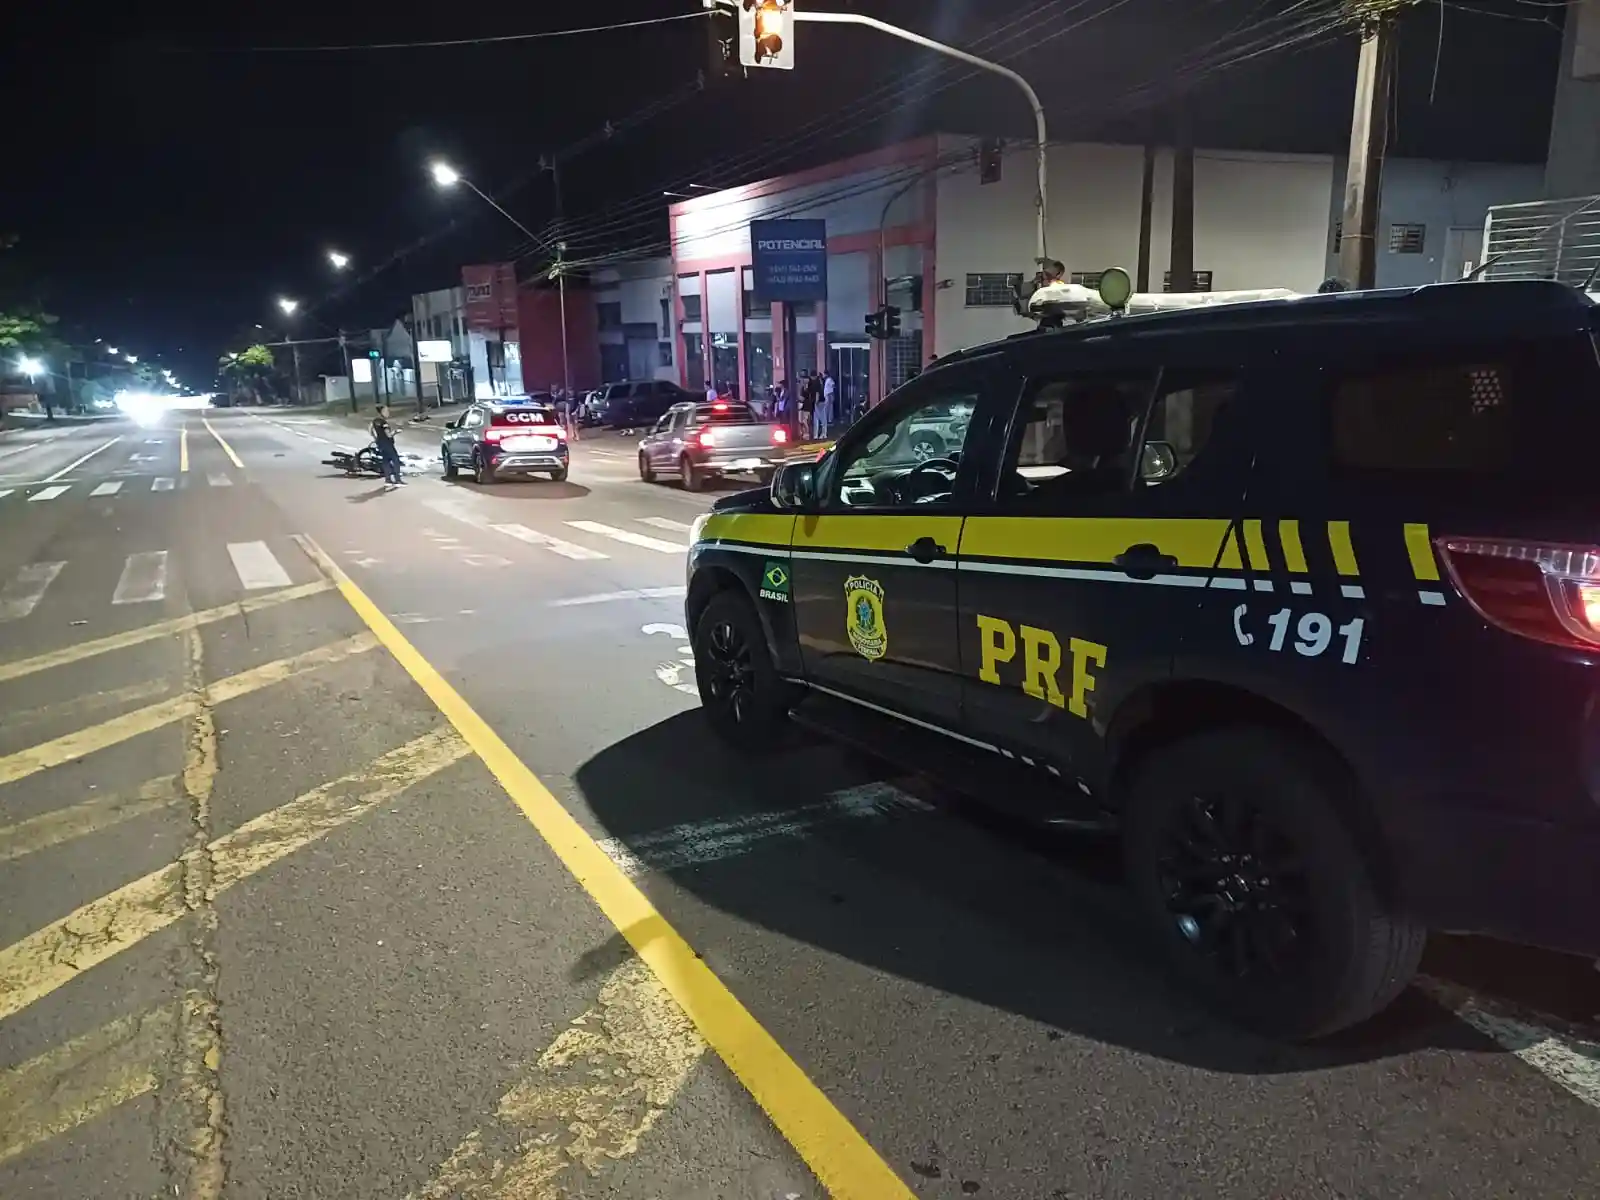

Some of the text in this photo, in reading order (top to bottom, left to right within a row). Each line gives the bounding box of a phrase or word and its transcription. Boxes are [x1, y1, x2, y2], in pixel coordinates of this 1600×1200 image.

[506, 412, 545, 423] GCM
[760, 588, 789, 603] BRASIL
[1268, 607, 1365, 665] 191
[977, 613, 1108, 719] PRF
